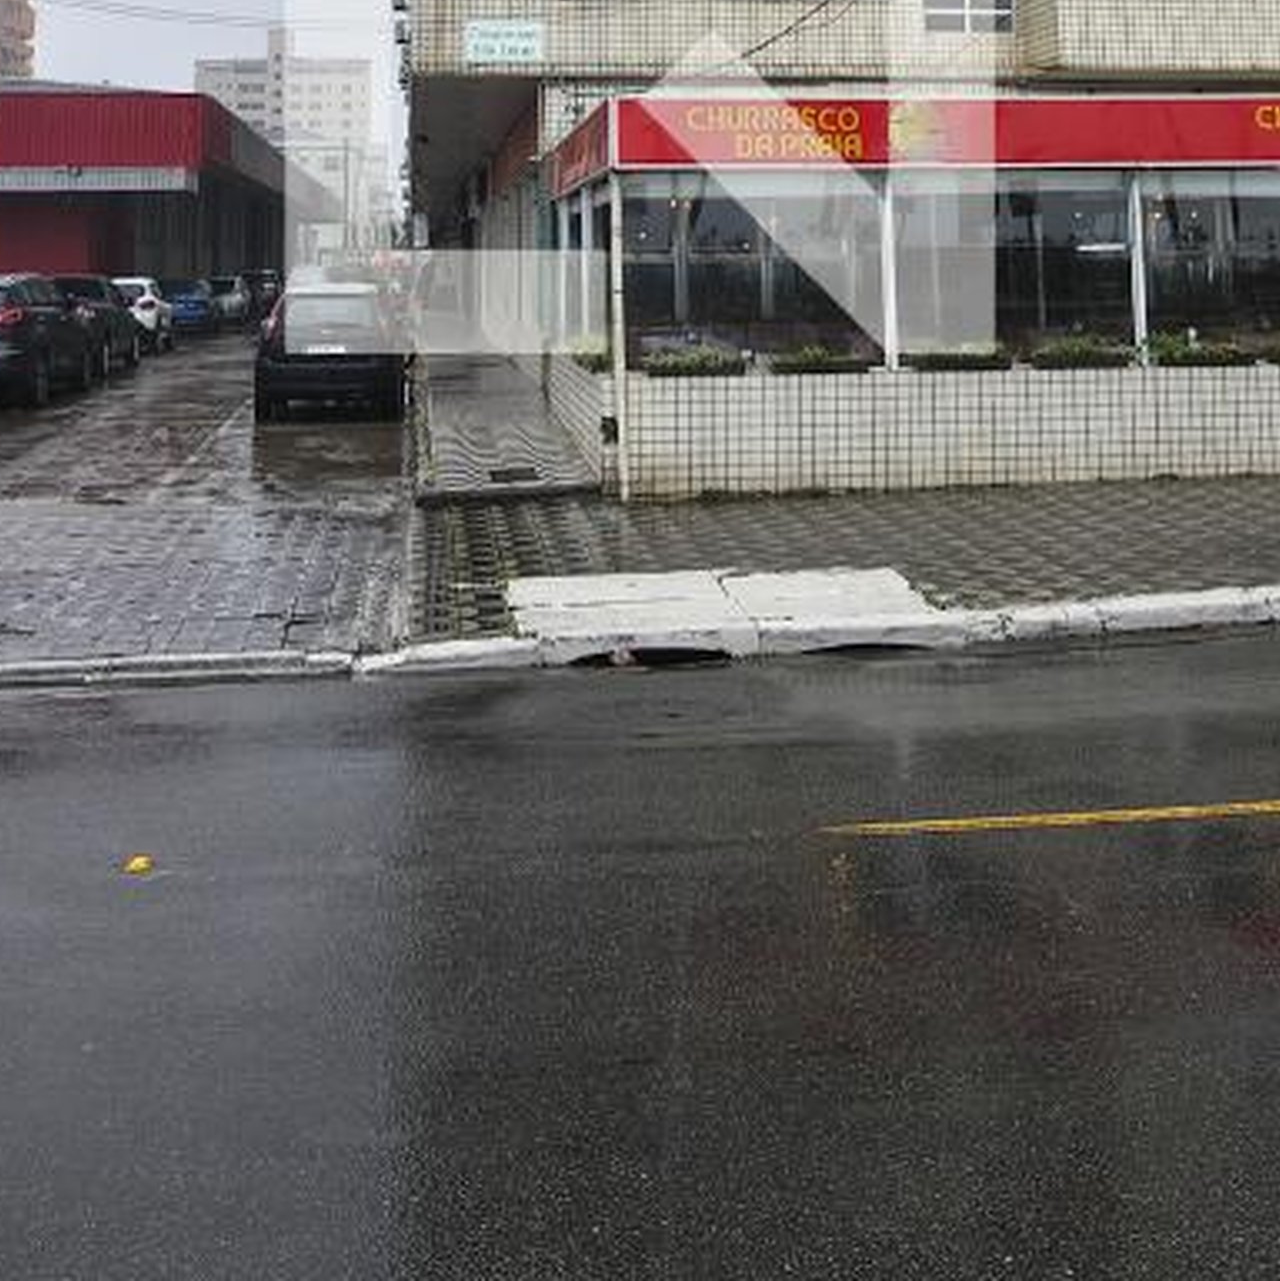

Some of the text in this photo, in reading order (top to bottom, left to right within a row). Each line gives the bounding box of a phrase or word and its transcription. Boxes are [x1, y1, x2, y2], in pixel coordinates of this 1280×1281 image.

[687, 106, 860, 131] CHURRASCO
[736, 132, 863, 160] DA PRAIA
